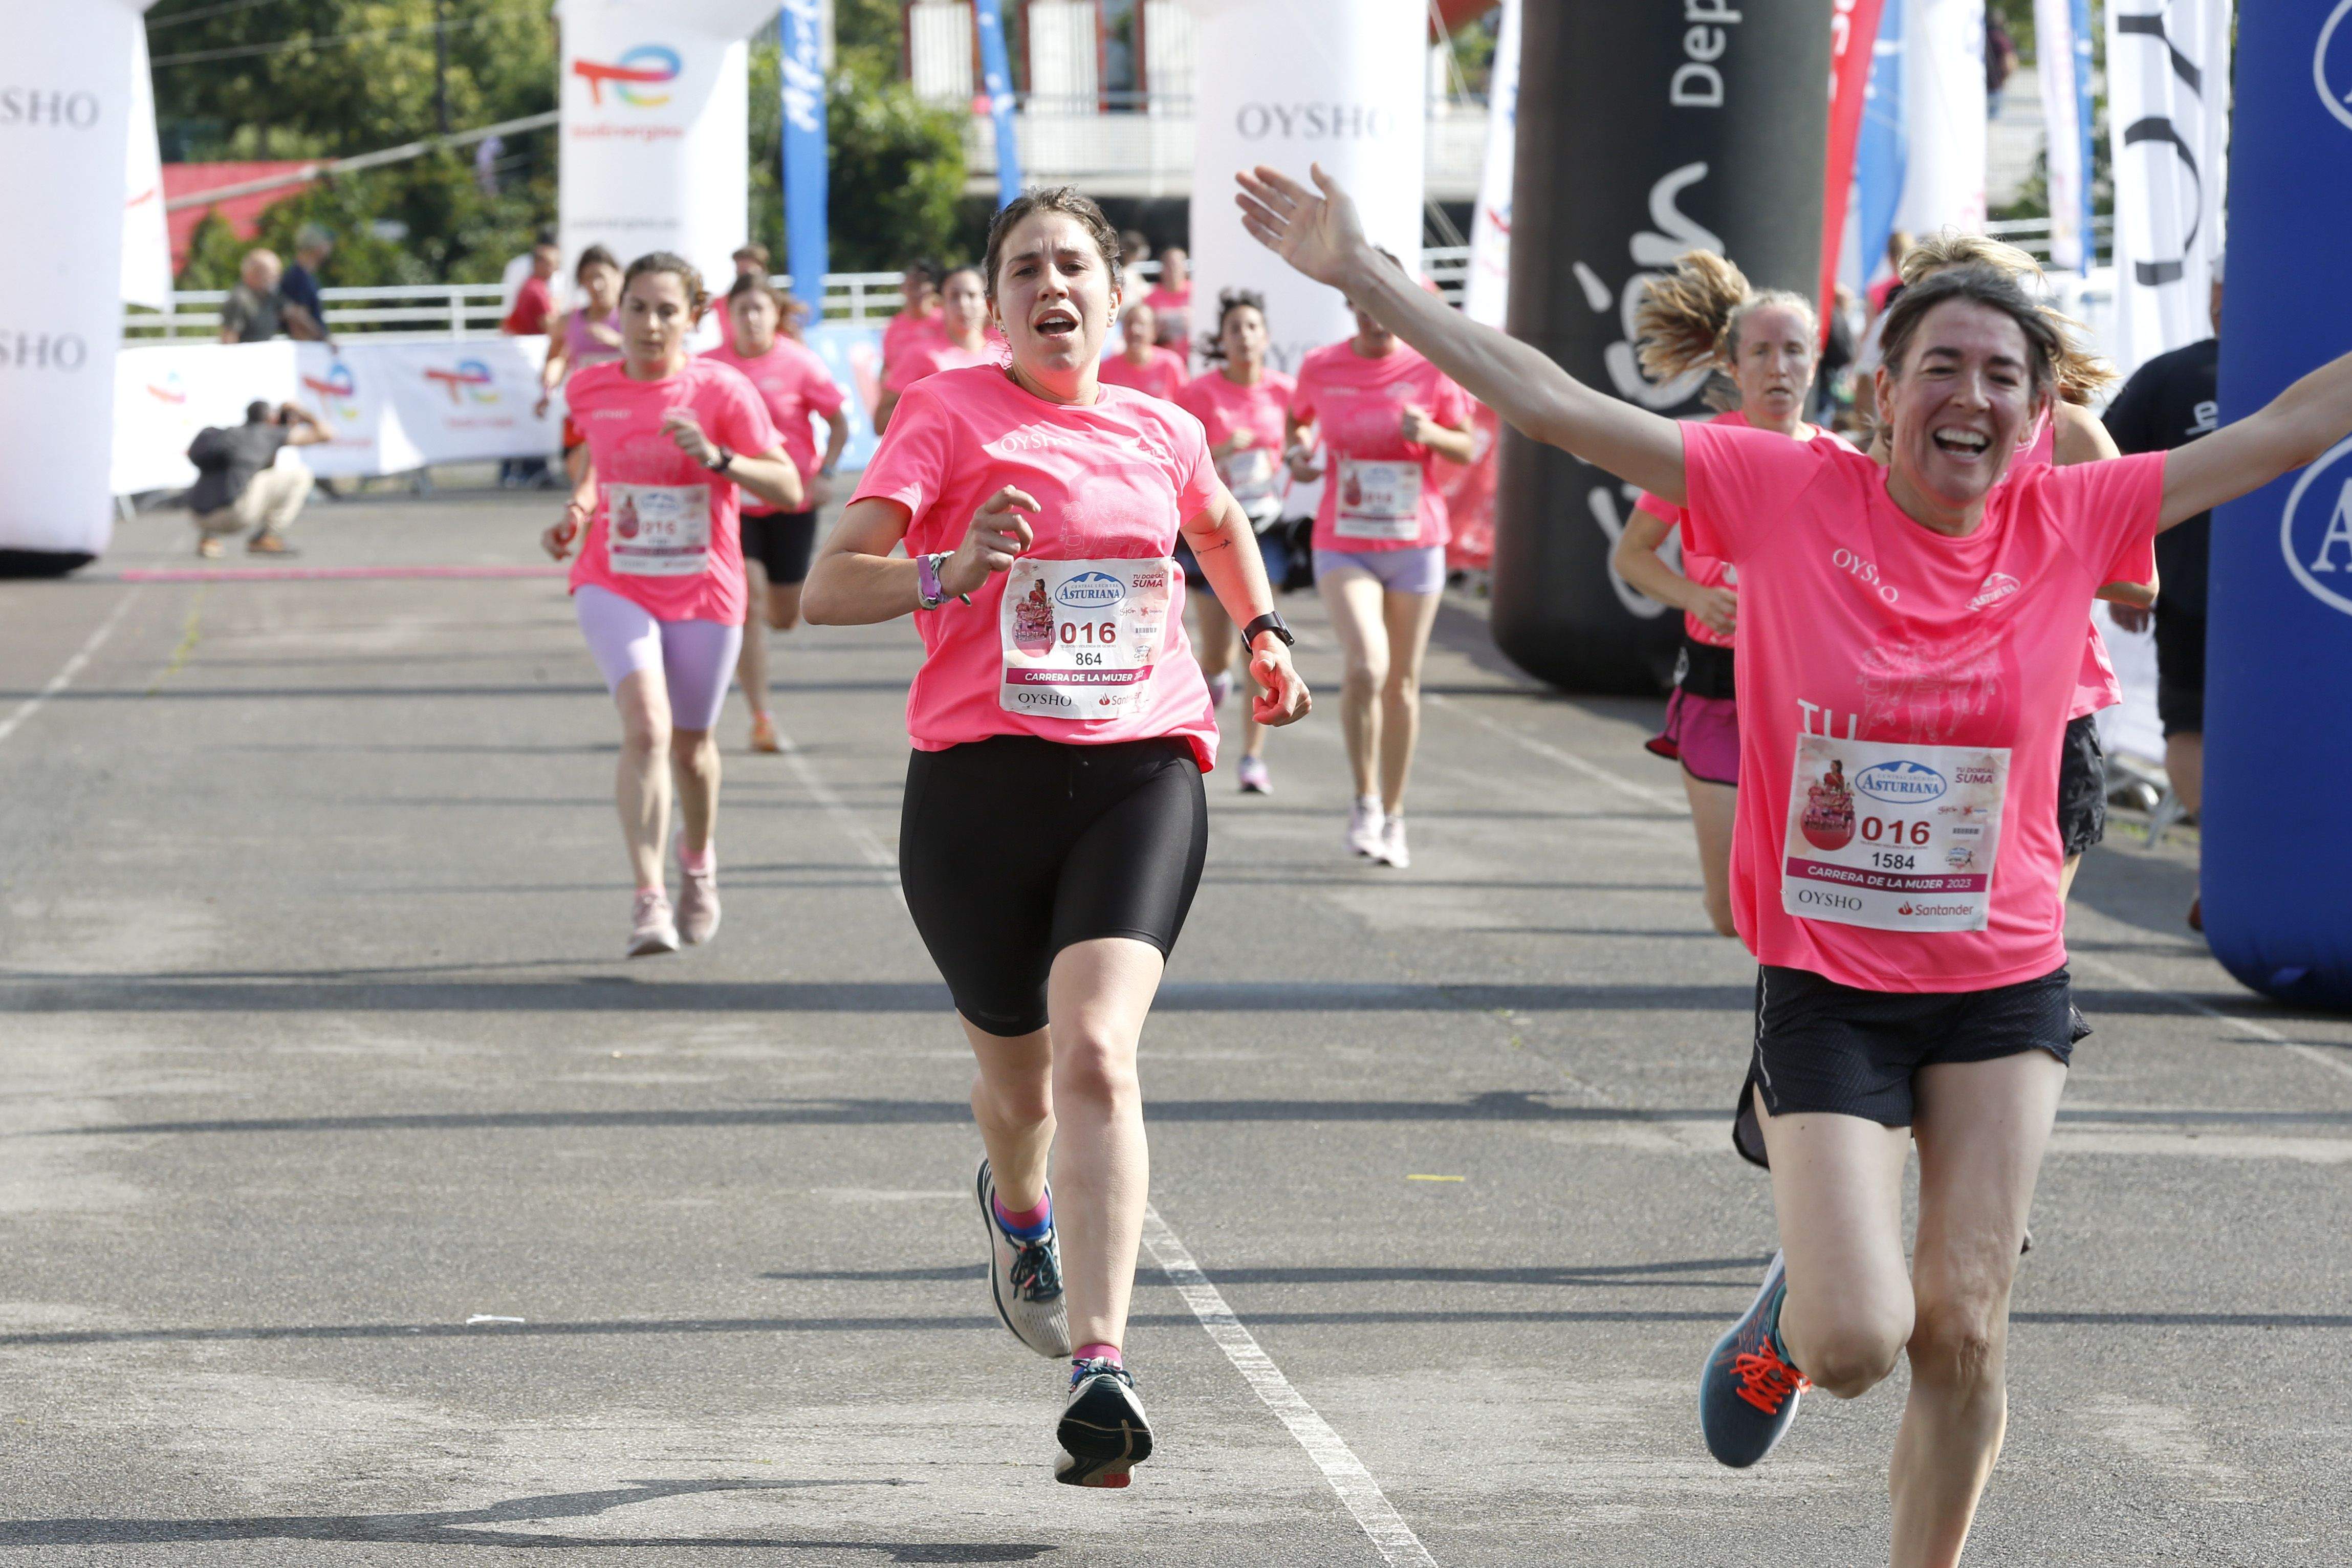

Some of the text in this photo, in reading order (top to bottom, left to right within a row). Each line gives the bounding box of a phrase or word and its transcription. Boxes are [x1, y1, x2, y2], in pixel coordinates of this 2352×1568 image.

[1235, 102, 1396, 140] OYSHO
[1132, 579, 1163, 587] SUMA
[1059, 586, 1120, 600] ASTURIANA
[1060, 622, 1116, 644] 016
[1076, 652, 1102, 666] 864
[1025, 673, 1070, 682] CARRERA
[1072, 673, 1085, 682] DE
[1087, 673, 1100, 682] LA
[1102, 673, 1133, 682] MUJER
[1018, 693, 1072, 707] OYSHO
[1112, 691, 1142, 706] Saner
[1862, 774, 1940, 794] ASTURIANA
[1955, 773, 1993, 784] SUMA
[1861, 816, 1931, 845] 016
[1872, 852, 1915, 870] 1584
[1807, 866, 1972, 889] CARRERA DE LA MUJER 2023
[1798, 889, 1863, 911] OYSHO
[1915, 903, 1974, 917] Santander
